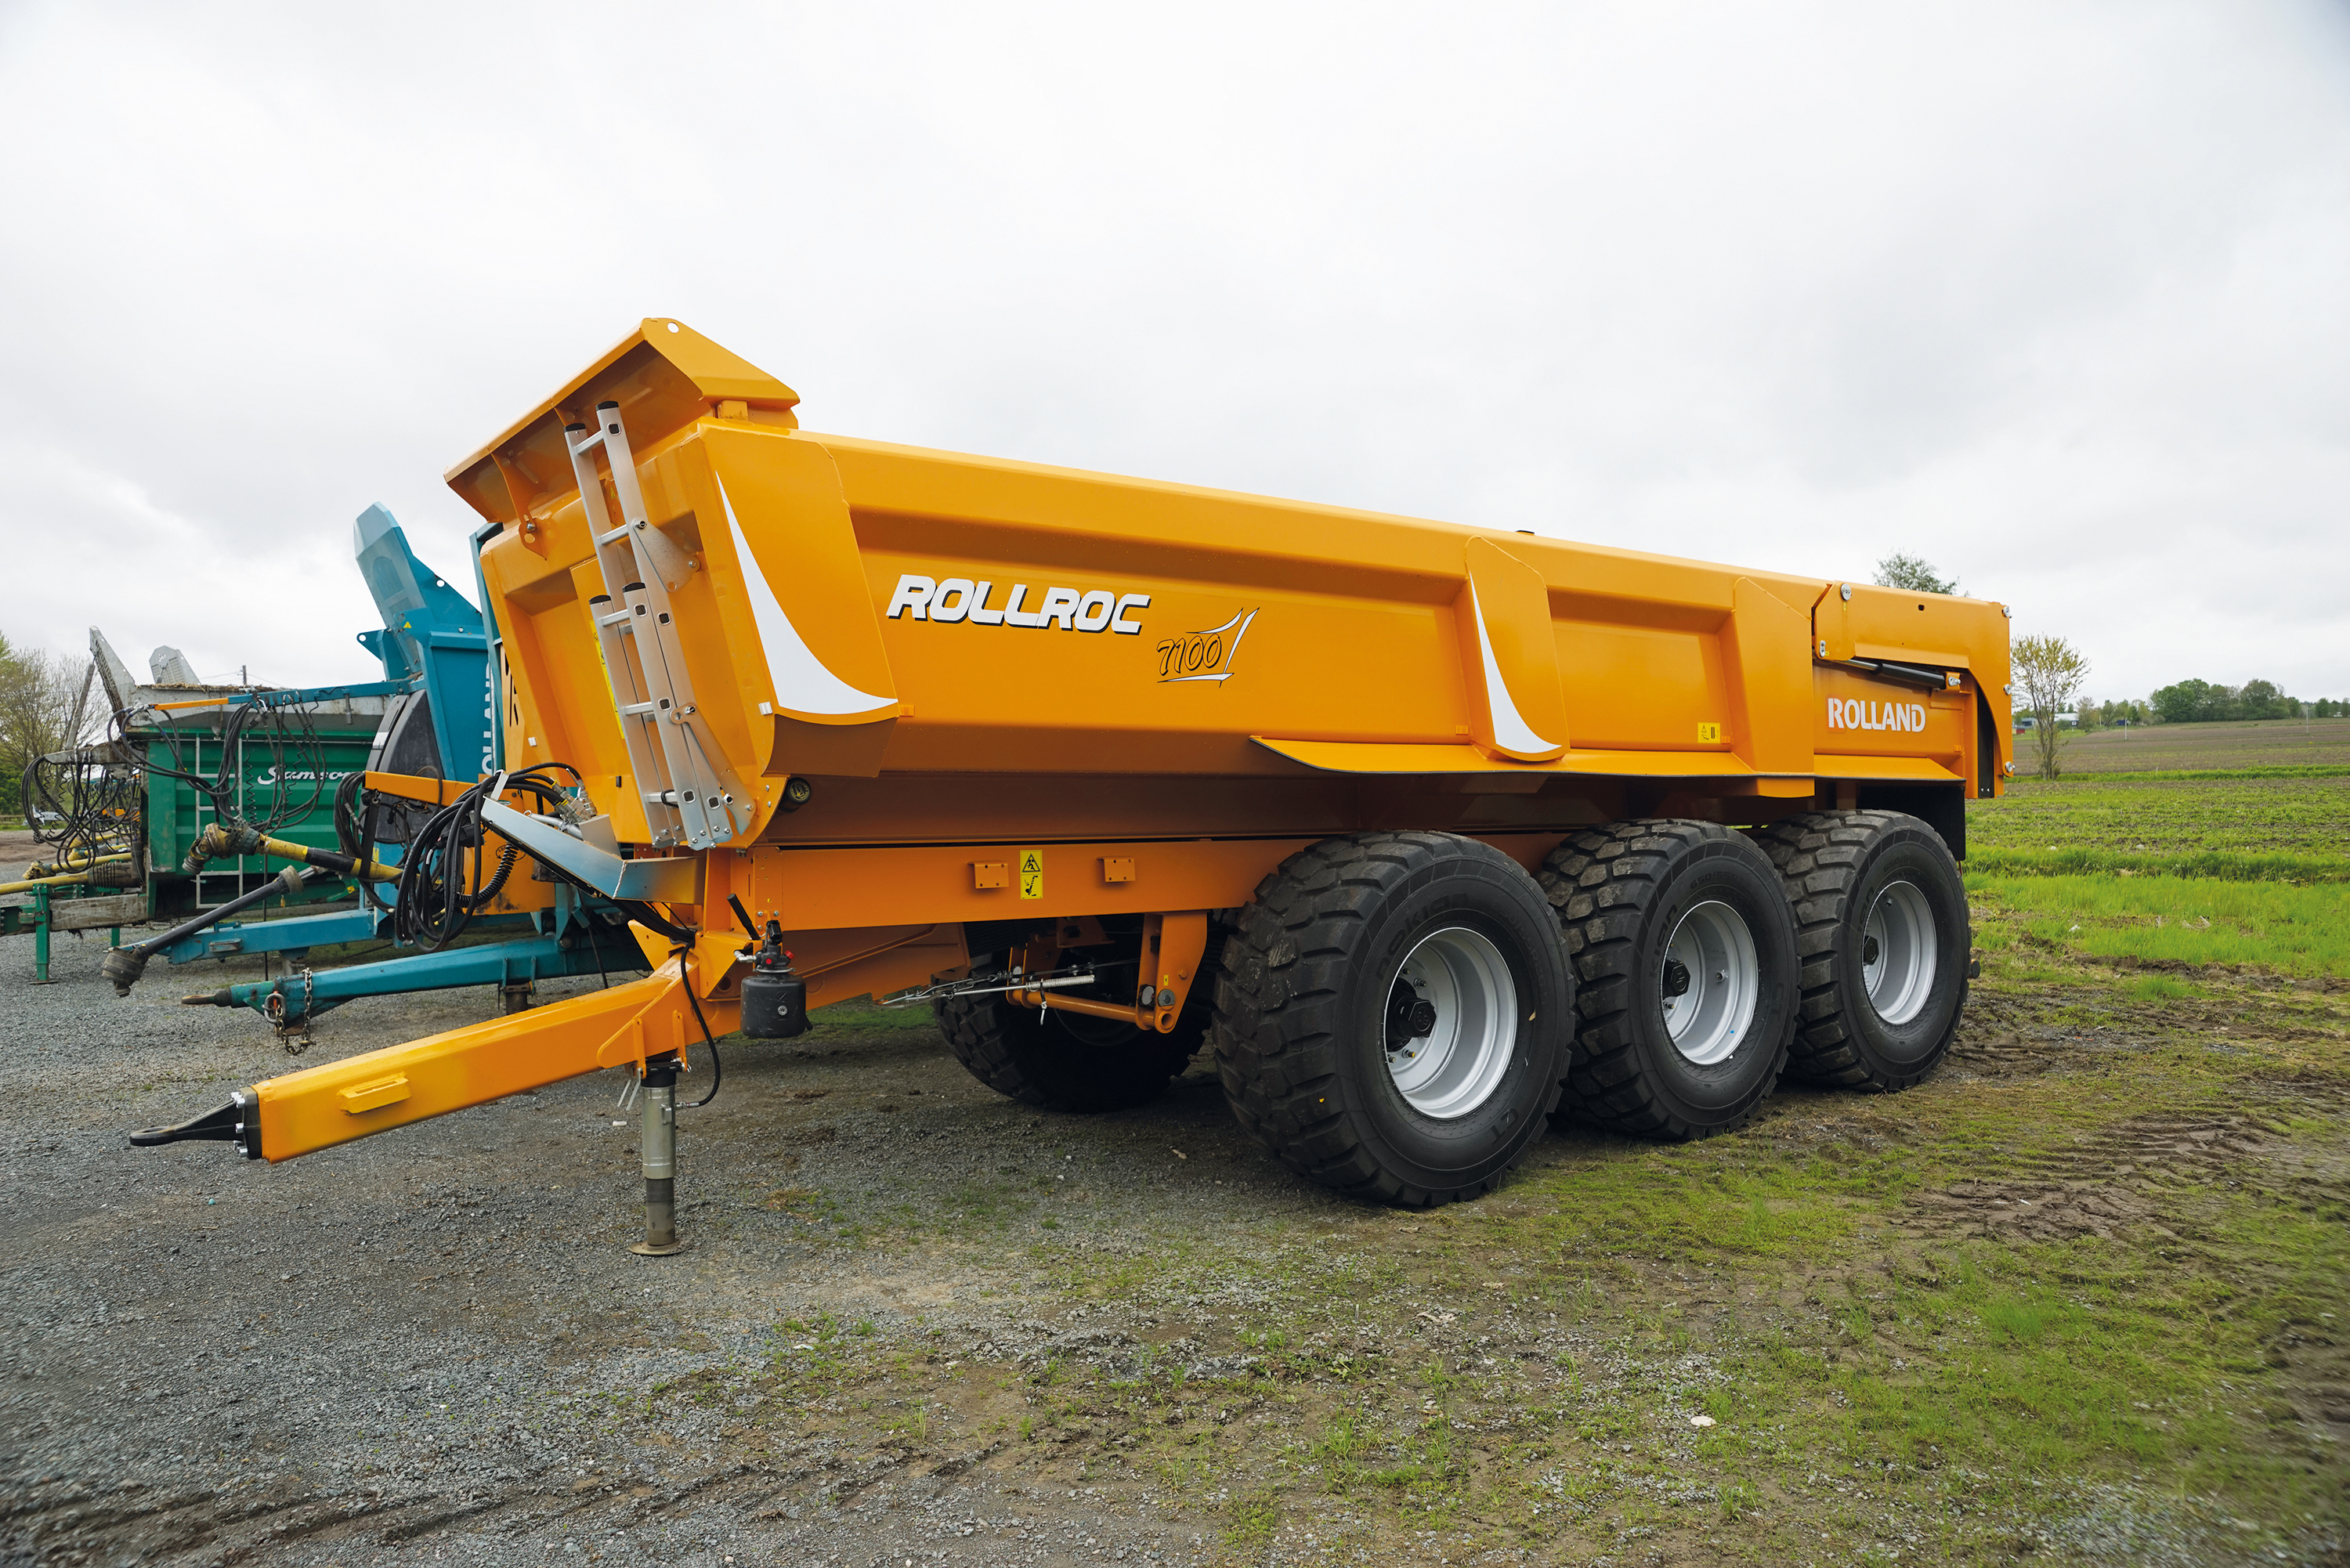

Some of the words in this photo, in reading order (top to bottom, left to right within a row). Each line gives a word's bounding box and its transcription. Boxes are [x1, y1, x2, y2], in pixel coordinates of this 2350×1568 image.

[886, 574, 1151, 635] ROLLROC
[1156, 633, 1222, 676] 7100
[1828, 698, 1926, 732] ROLLAND
